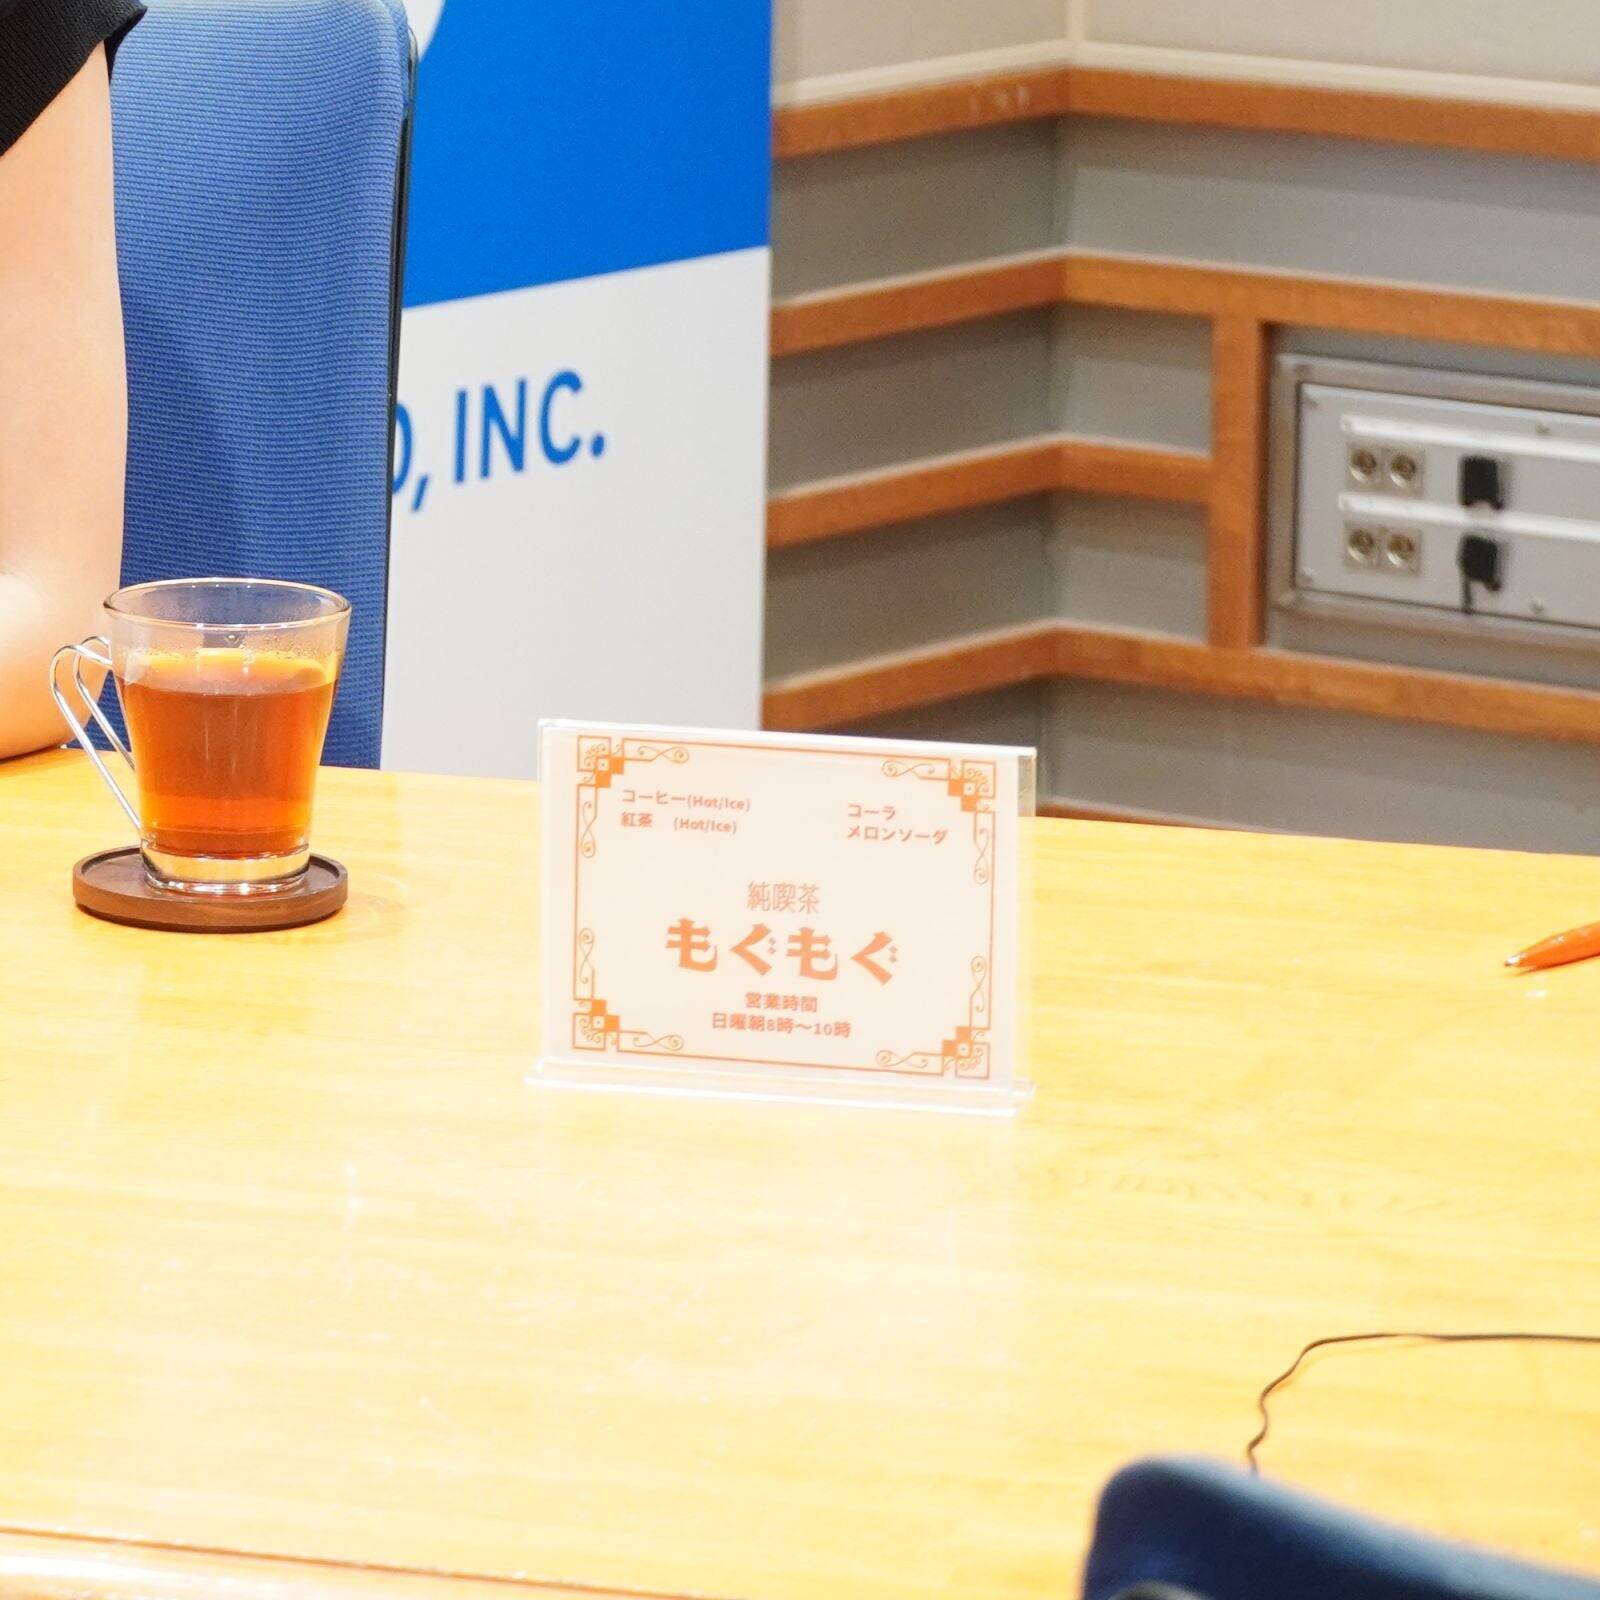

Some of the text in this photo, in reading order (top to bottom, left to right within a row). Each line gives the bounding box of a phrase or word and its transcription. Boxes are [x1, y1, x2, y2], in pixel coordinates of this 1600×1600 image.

[454, 370, 606, 483] INC.
[620, 811, 653, 828] 紅茶
[848, 803, 896, 821] コーラ
[847, 825, 949, 845] メロンソーダ
[747, 880, 820, 915] 純喫茶
[665, 918, 898, 986] もぐもぐ
[745, 992, 819, 1013] 営業時間
